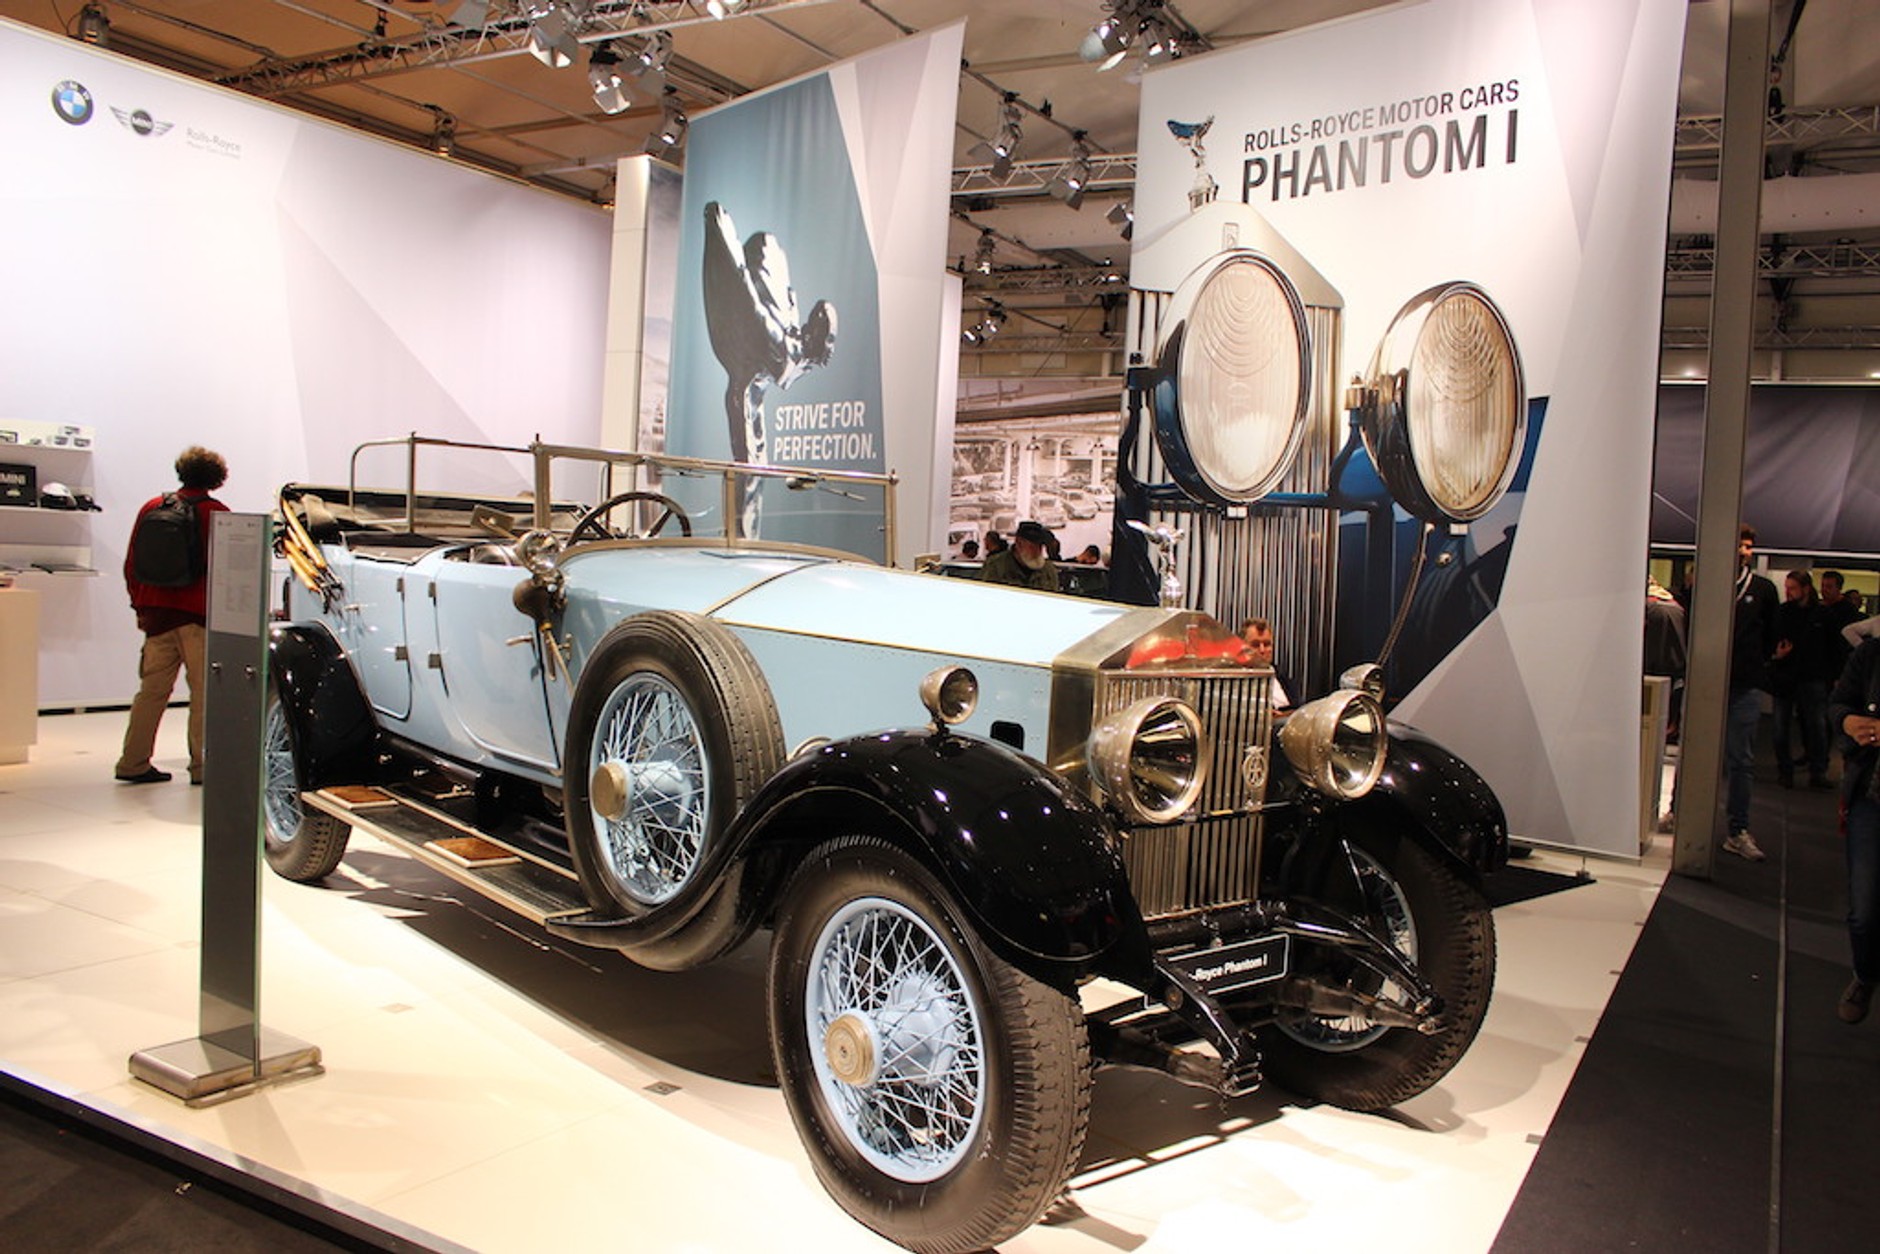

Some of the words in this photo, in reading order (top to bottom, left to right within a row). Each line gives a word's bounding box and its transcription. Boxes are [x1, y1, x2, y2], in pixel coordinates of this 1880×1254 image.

[1244, 107, 1374, 153] ROLLS-ROYCE
[1378, 92, 1454, 126] MOTOR
[1459, 79, 1519, 111] CARS
[1242, 114, 1488, 204] PHANTOM
[1505, 108, 1519, 164] I
[775, 404, 829, 430] STRIVE
[832, 401, 865, 428] FOR
[774, 433, 877, 461] PERFECTION.
[1224, 957, 1262, 974] Phantom
